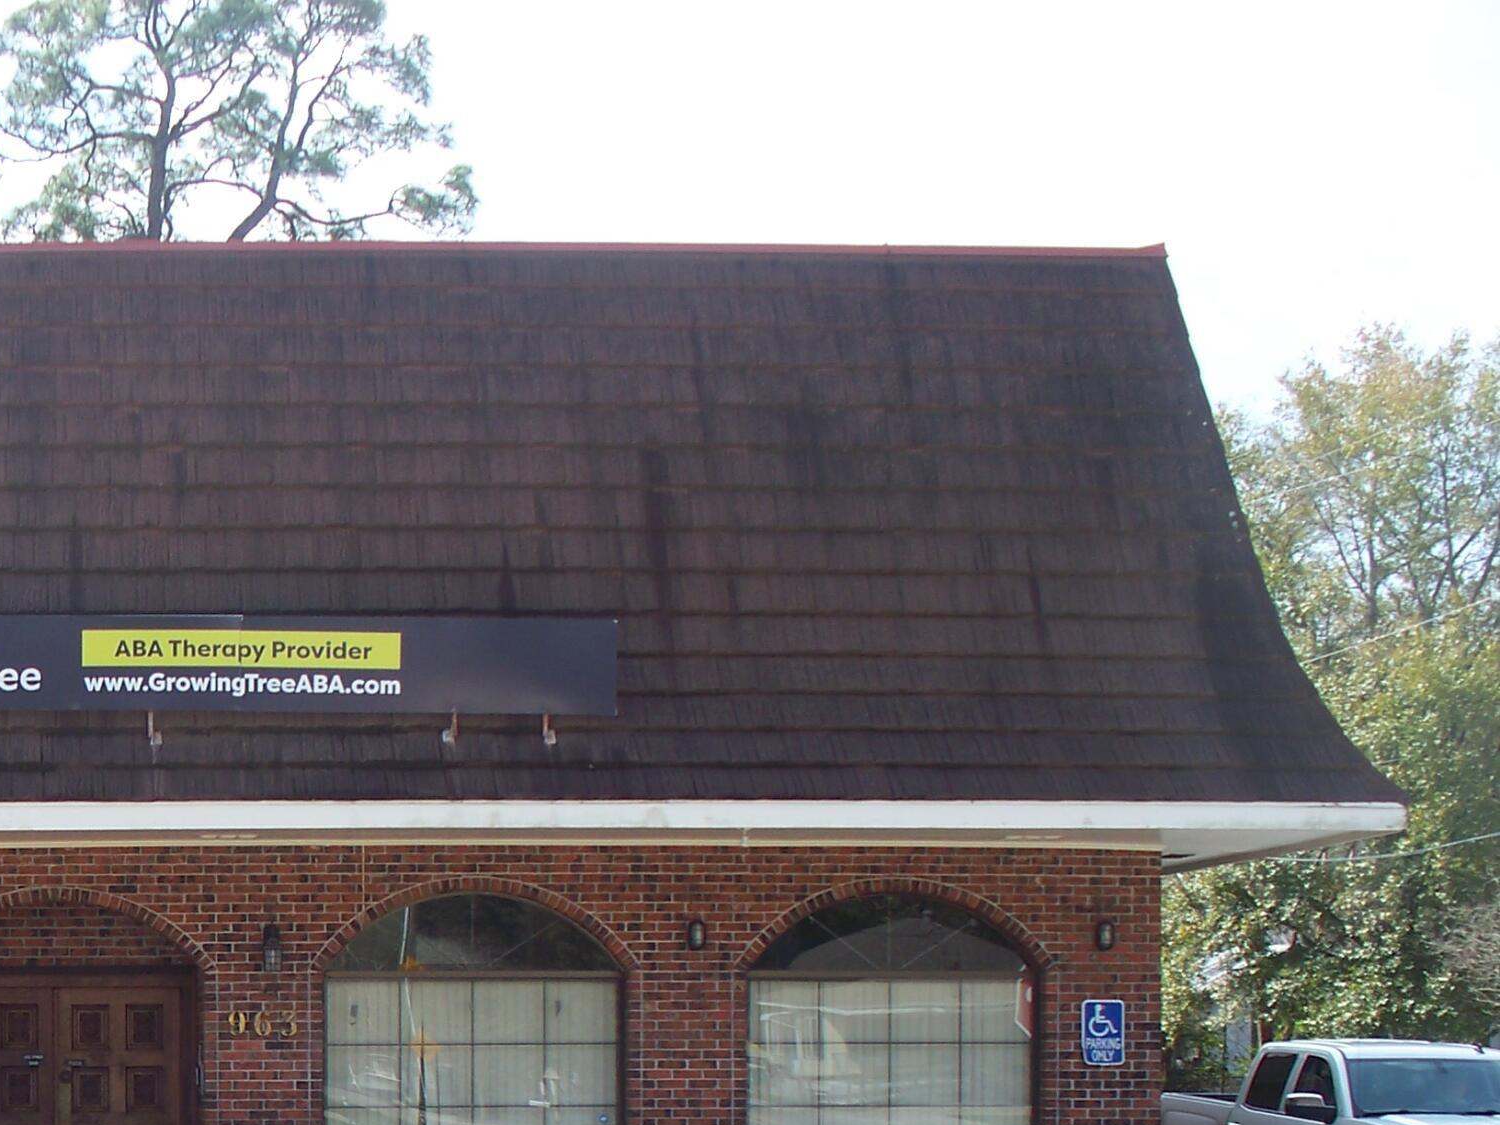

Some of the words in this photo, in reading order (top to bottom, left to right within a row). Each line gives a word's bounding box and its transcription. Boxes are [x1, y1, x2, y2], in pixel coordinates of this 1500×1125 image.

[114, 639, 164, 657] ABA
[168, 640, 266, 663] Therapy
[271, 641, 373, 660] Provider
[84, 672, 401, 696] www.GrowingTreeABA.com
[228, 1010, 298, 1037] 963
[1085, 1038, 1121, 1050] PARKING
[1091, 1050, 1115, 1061] ONLY
